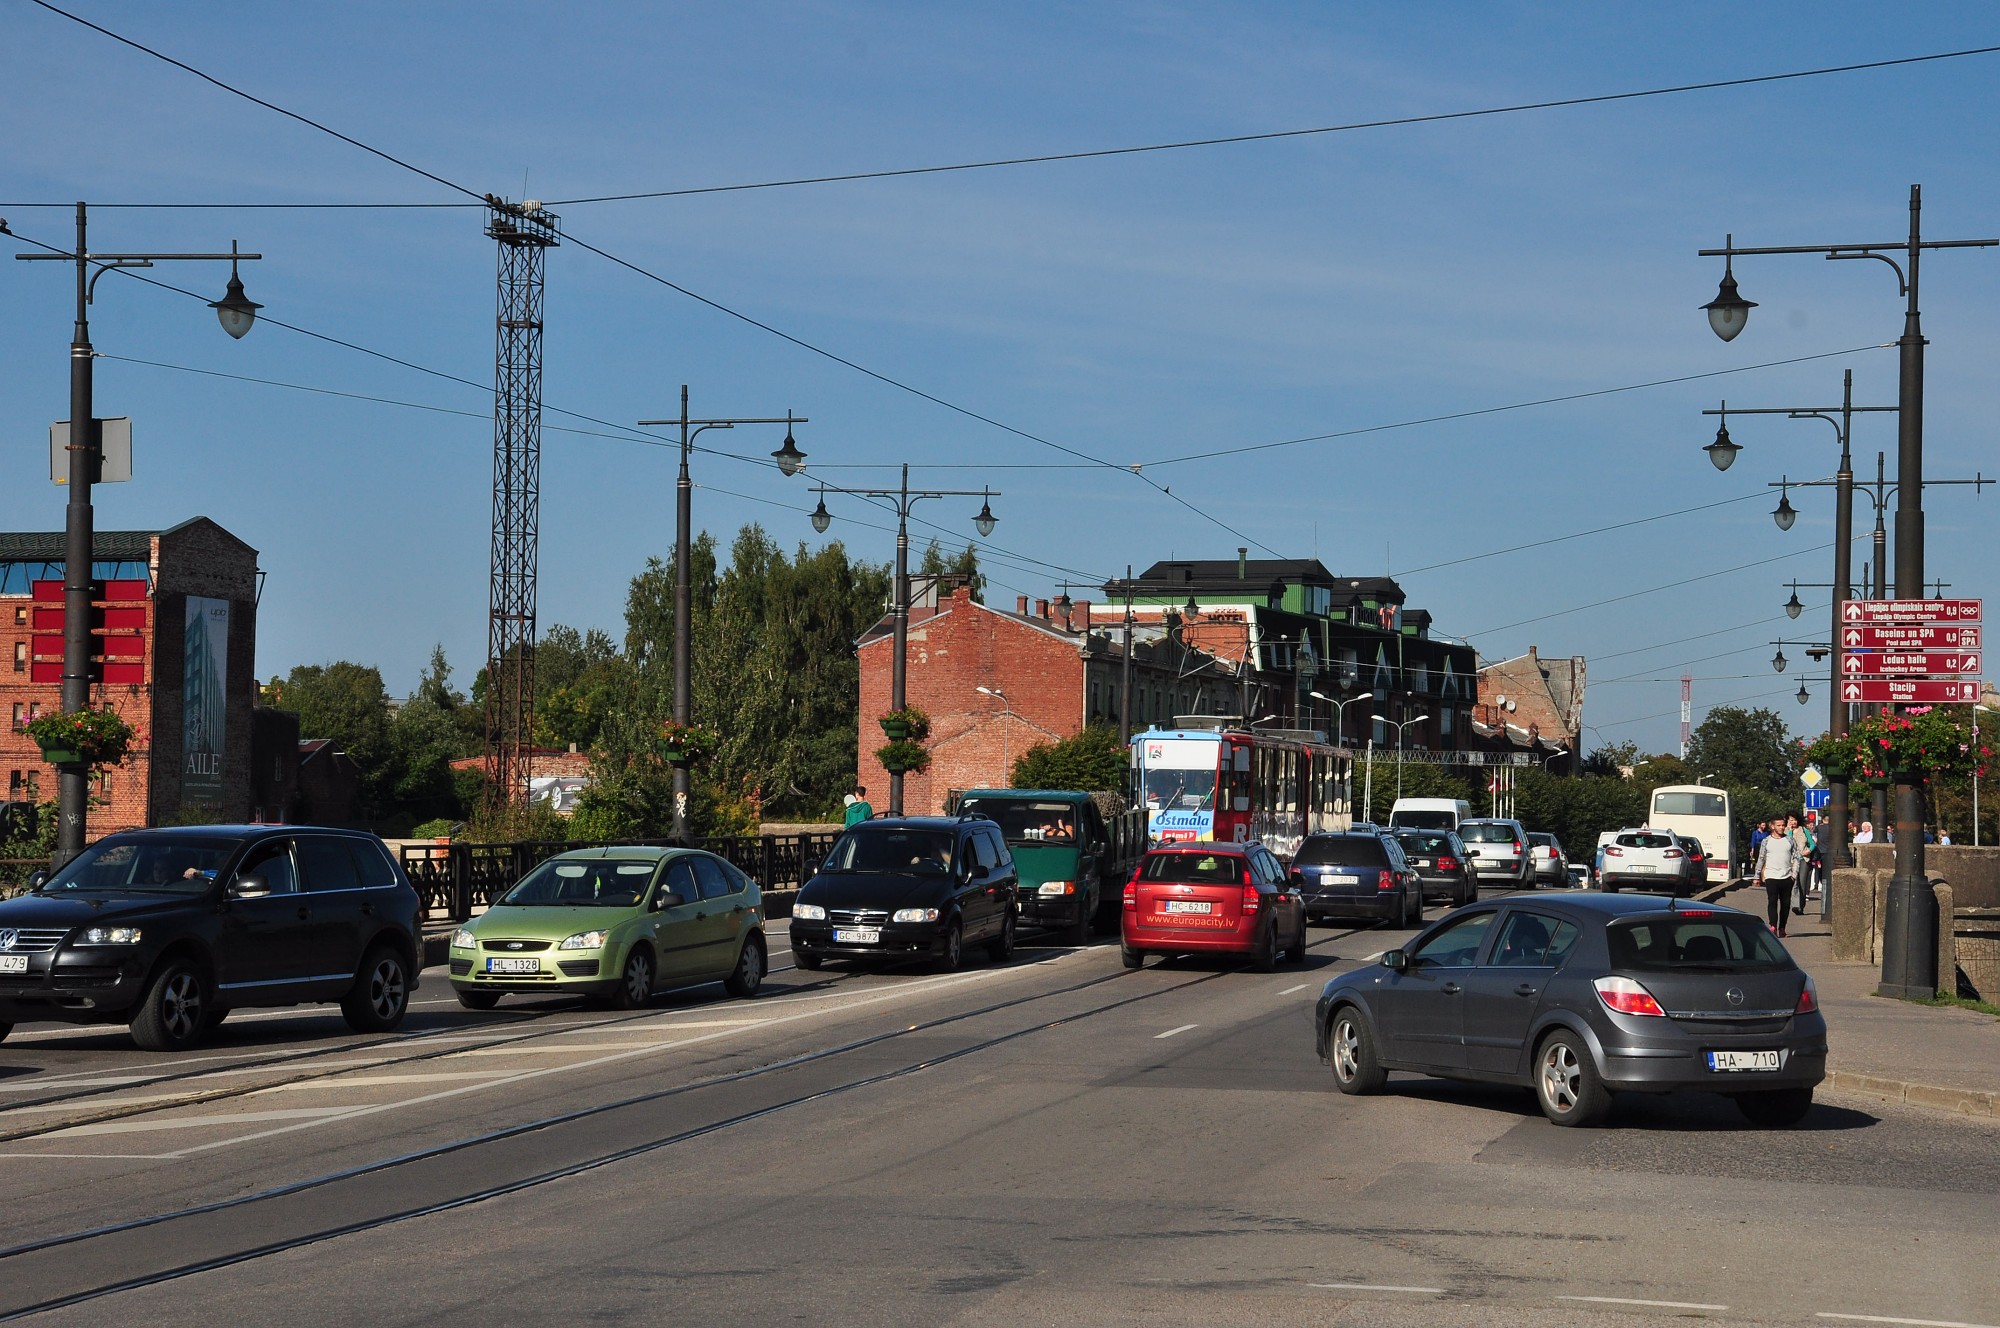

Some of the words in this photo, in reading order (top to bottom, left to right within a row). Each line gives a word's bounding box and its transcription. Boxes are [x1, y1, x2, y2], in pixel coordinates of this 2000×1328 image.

[1890, 602, 1924, 613] olimpiskais
[1947, 606, 1957, 617] 0,9
[1875, 629, 1906, 638] Baseins
[1908, 630, 1918, 638] un
[1919, 628, 1935, 638] SPA
[1946, 632, 1957, 643] 0,9
[1961, 636, 1976, 646] SPA
[1882, 655, 1906, 664] Ledus
[1907, 654, 1927, 664] halle
[1946, 658, 1957, 668] 0,2
[1889, 682, 1916, 693] Stacija
[1945, 686, 1956, 696] 1,2
[185, 753, 221, 775] AILE
[1146, 914, 1234, 928] www.europacity.lv
[4, 957, 26, 969] 479
